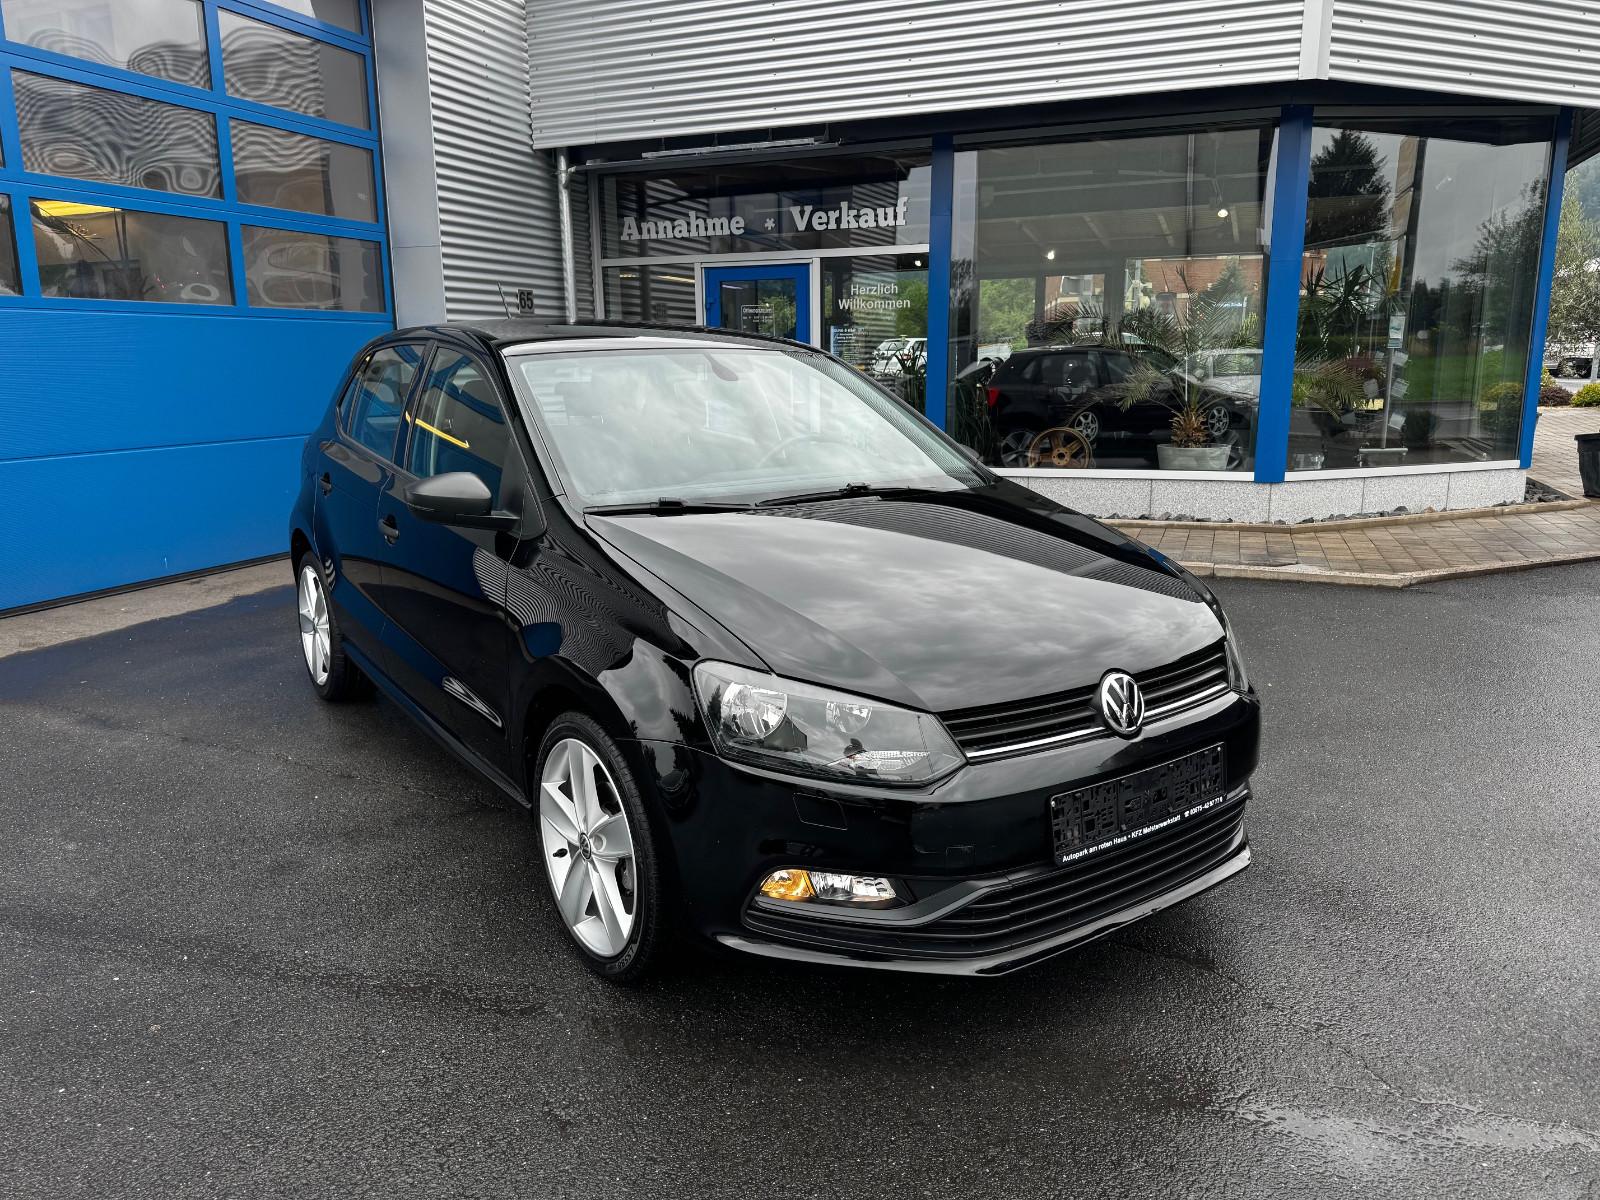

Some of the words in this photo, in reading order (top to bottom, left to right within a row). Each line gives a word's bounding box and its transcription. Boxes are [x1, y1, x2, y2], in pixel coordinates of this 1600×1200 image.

[620, 210, 745, 240] Annahme
[790, 196, 908, 231] Verkauf
[850, 283, 898, 296] Herzlich
[519, 291, 534, 310] 65
[838, 297, 911, 310] Willkommen
[1062, 848, 1089, 863] Autopark
[1089, 846, 1098, 854] am
[1098, 840, 1113, 851] roten
[1113, 836, 1127, 845] Haus
[1131, 828, 1143, 839] KFZ
